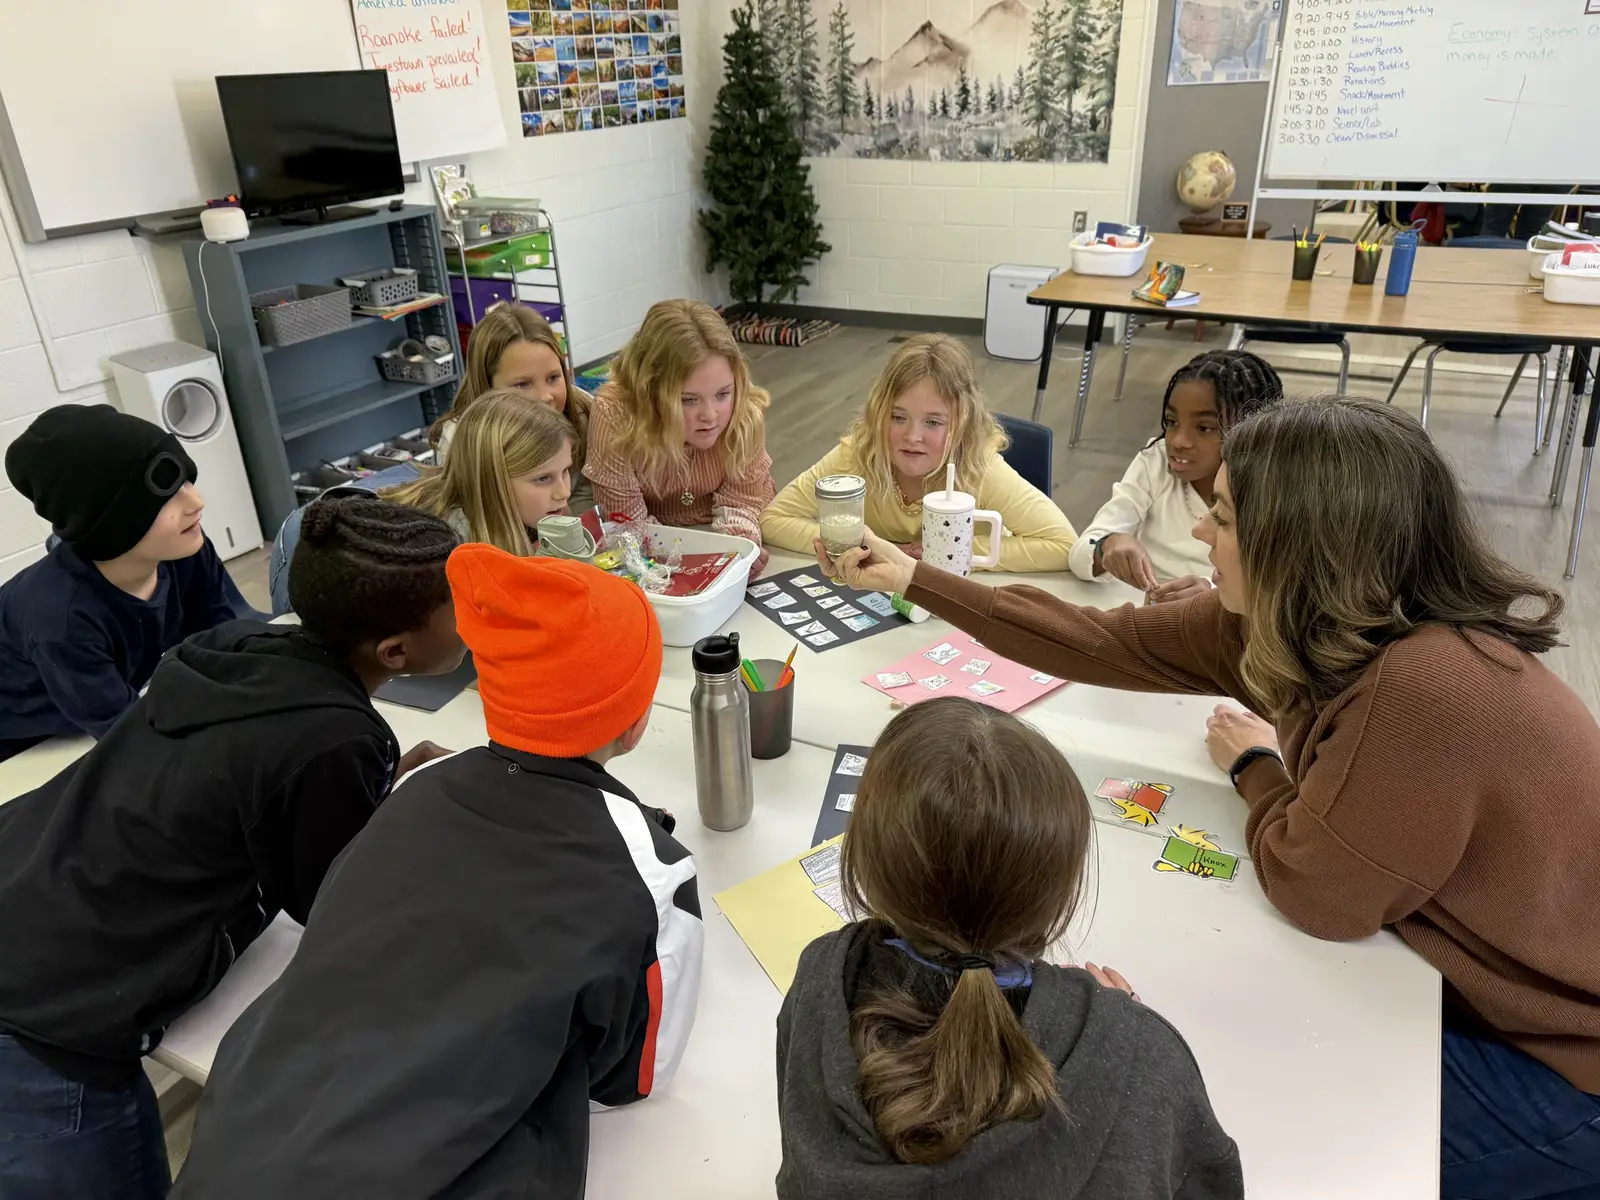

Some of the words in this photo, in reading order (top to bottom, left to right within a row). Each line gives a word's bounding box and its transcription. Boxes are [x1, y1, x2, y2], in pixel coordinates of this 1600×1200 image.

[358, 25, 423, 48] Roanoke
[430, 10, 472, 39] failed!
[1351, 36, 1383, 46] History
[1446, 51, 1490, 69] money
[1496, 50, 1509, 61] is
[1514, 48, 1555, 61] made
[1346, 63, 1376, 75] Reading
[1377, 60, 1410, 71] Buddies
[1344, 76, 1386, 85] Rotations
[1339, 88, 1405, 100] Snack/Movement
[1203, 855, 1227, 868] Knox
